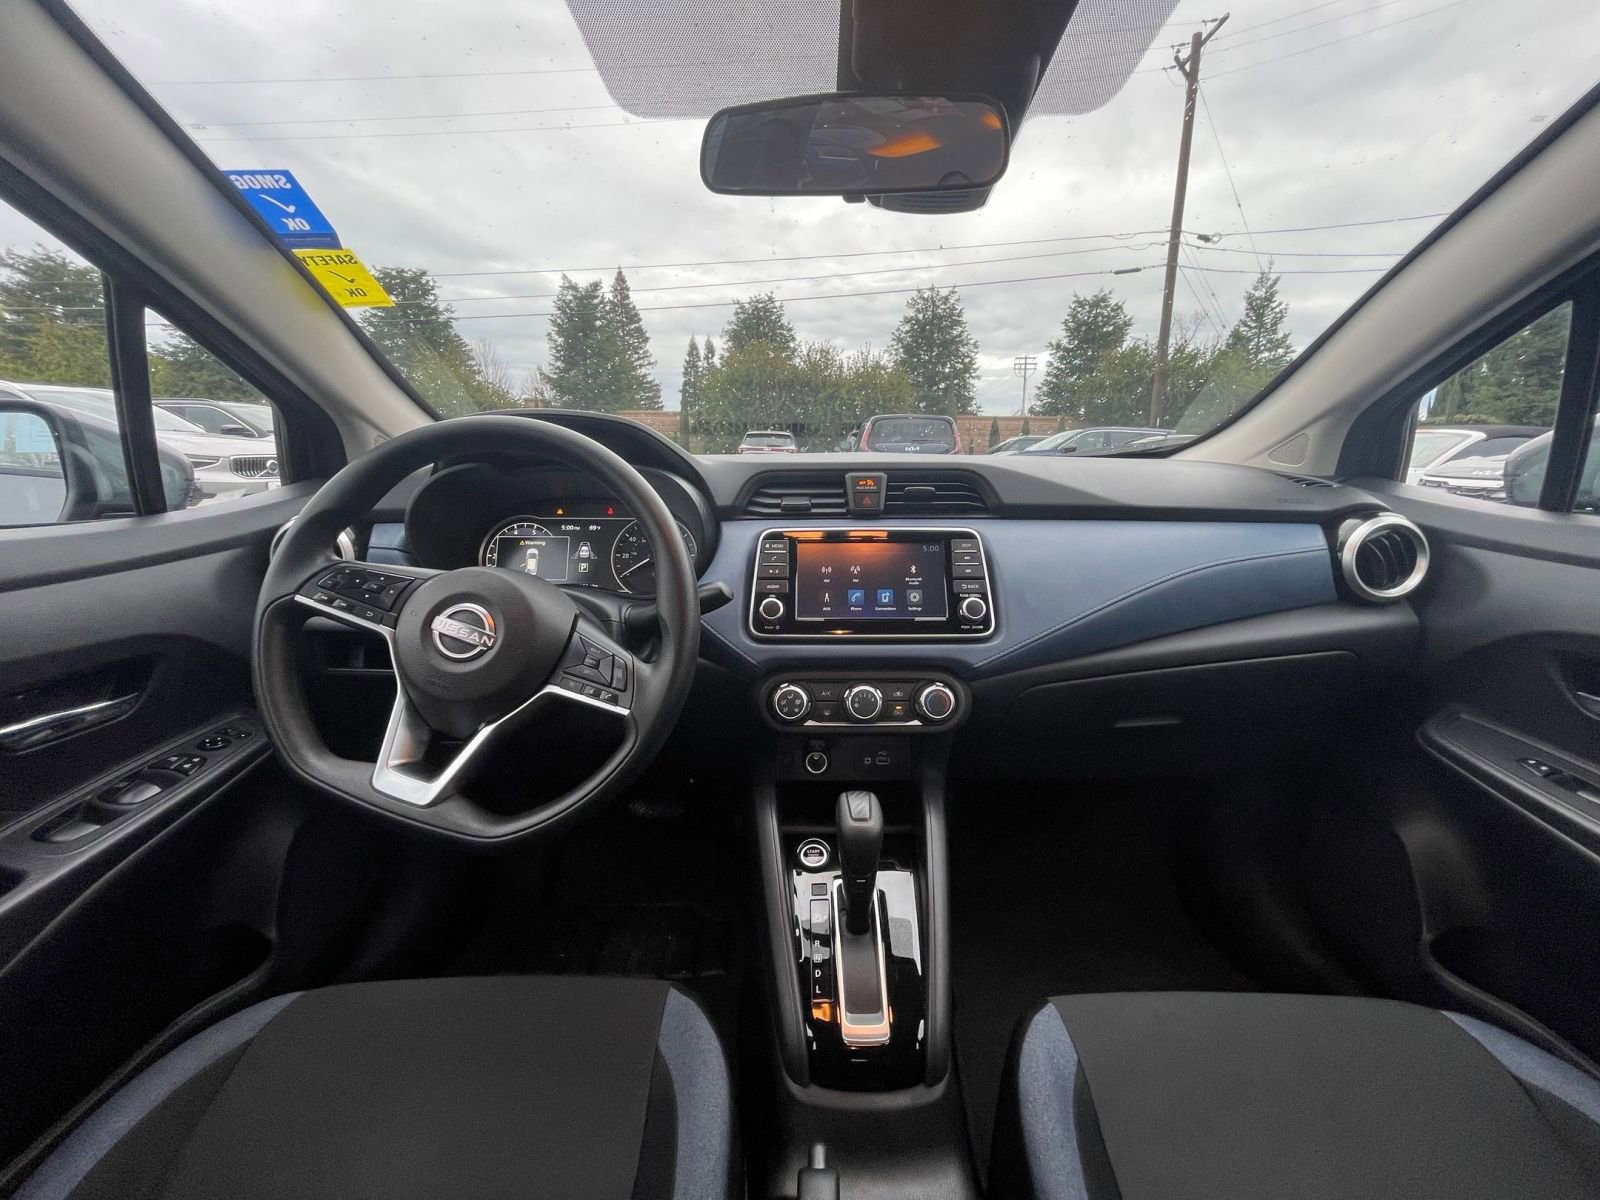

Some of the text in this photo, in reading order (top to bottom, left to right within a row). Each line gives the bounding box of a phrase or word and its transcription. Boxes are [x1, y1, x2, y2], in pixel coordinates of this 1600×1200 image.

[433, 616, 495, 647] NISSAN
[814, 969, 822, 977] D
[815, 985, 821, 994] L
